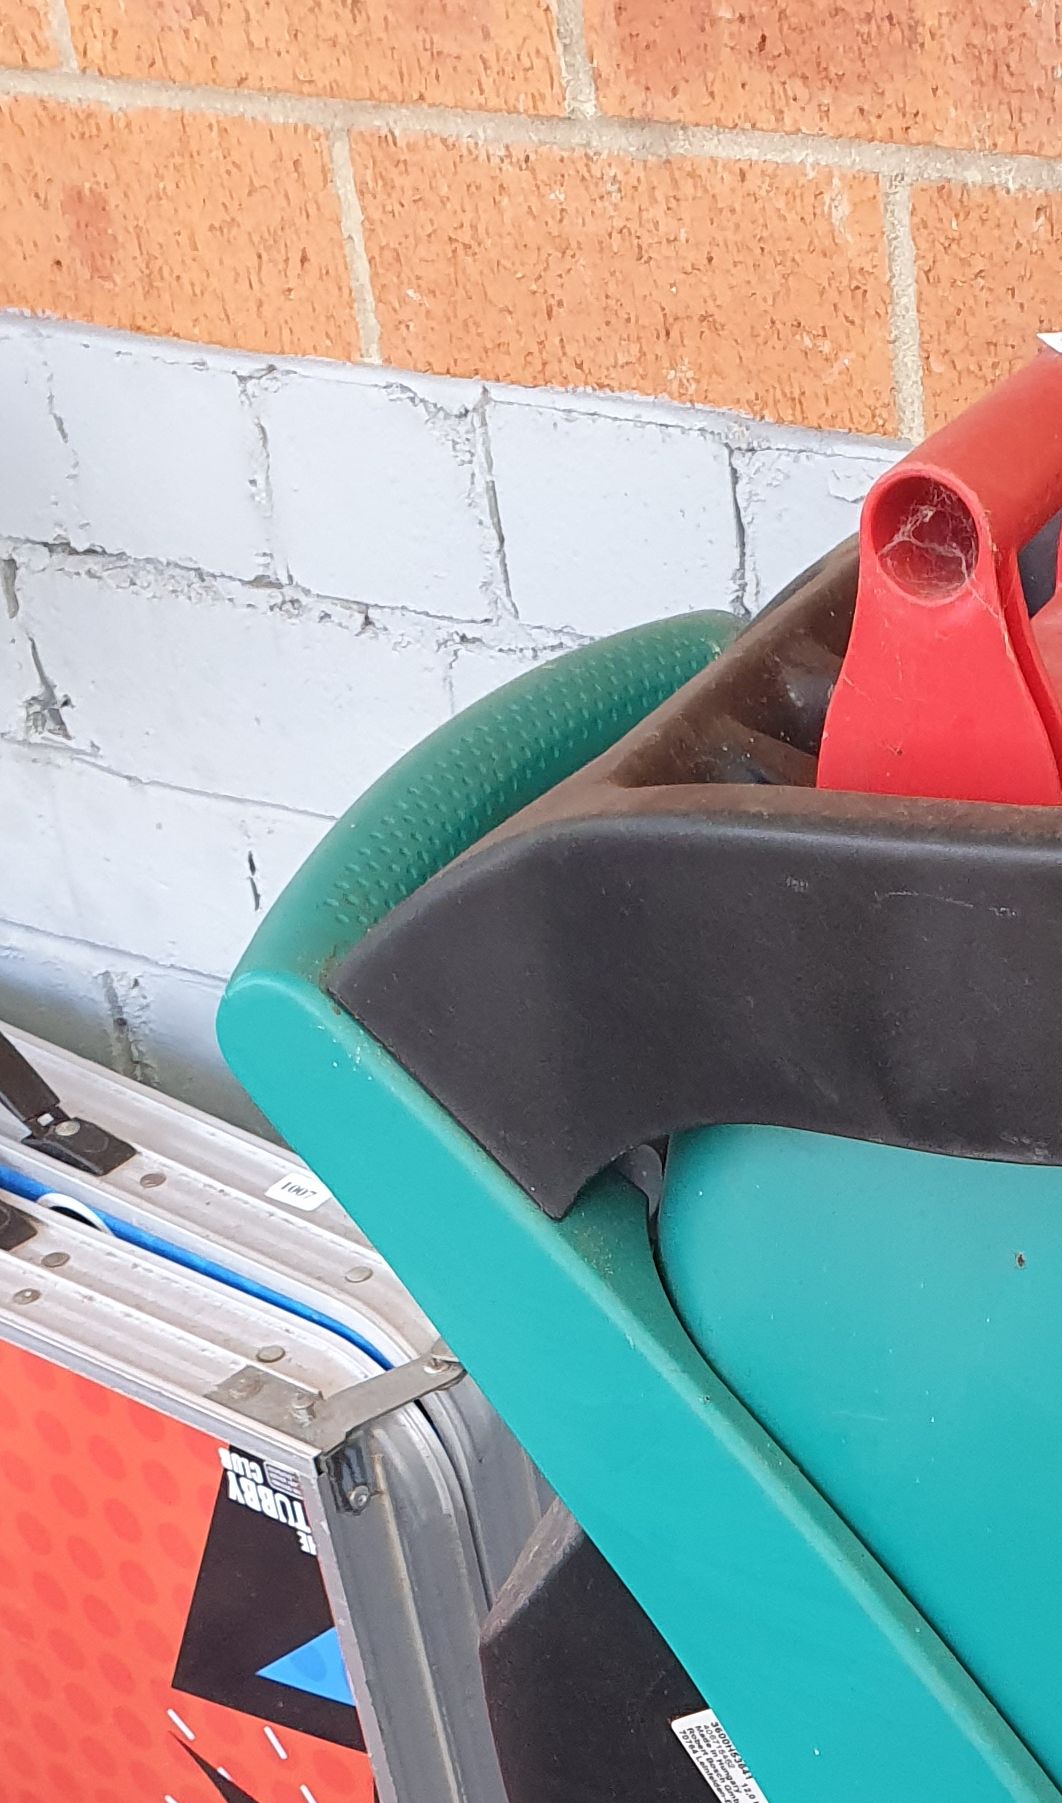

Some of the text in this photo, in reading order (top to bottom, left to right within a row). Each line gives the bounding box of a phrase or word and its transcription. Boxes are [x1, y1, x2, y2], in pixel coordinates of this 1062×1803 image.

[281, 1181, 318, 1201] 1007
[218, 1447, 263, 1484] CLUB
[226, 1471, 311, 1533] TUBBY
[687, 1727, 709, 1756] Robert
[706, 1757, 726, 1783] Bosch
[695, 1725, 713, 1748] Made
[710, 1749, 719, 1757] in
[716, 1758, 742, 1794] Hungary
